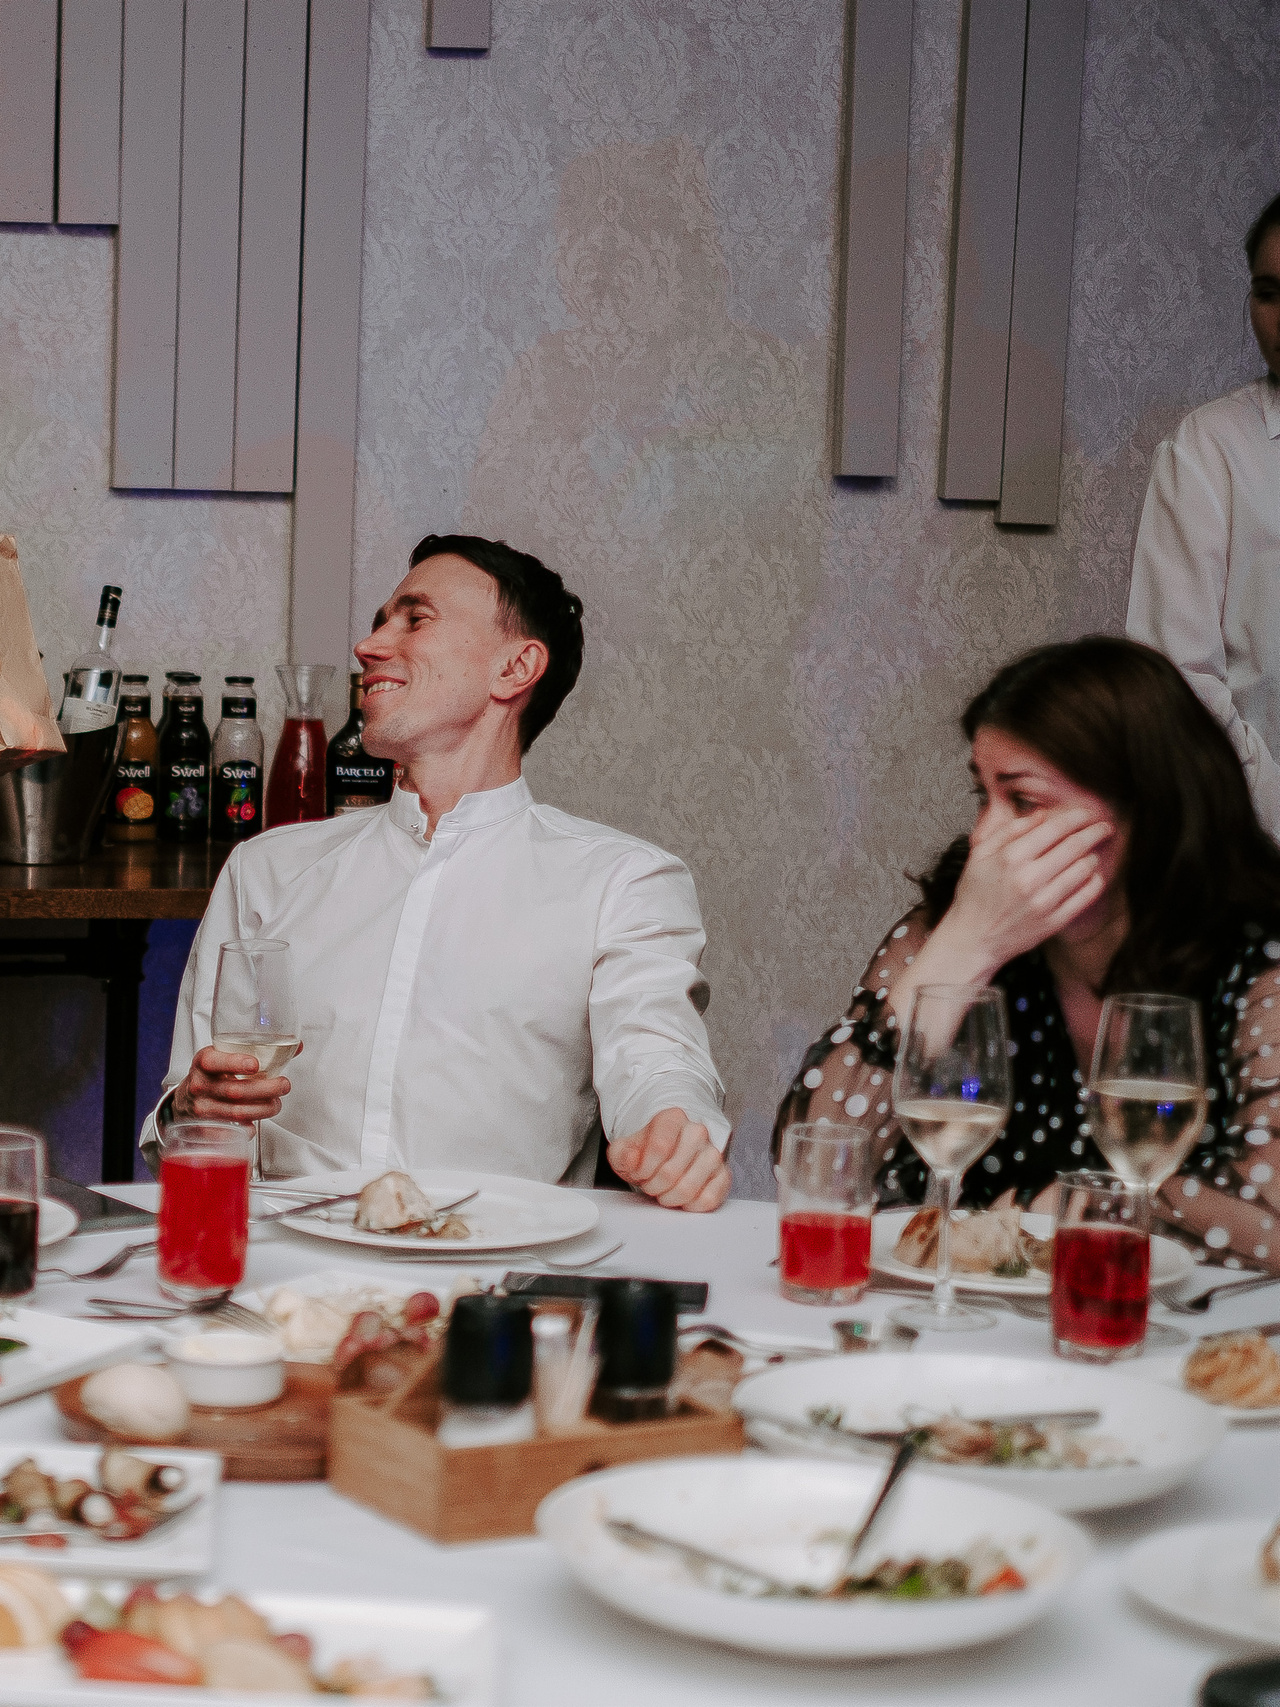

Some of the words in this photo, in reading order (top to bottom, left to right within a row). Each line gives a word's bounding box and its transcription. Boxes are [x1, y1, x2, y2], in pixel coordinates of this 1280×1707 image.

[117, 765, 150, 778] Swell
[171, 764, 205, 778] Swell
[223, 766, 256, 779] Swell
[336, 766, 385, 778] BARCELÓ
